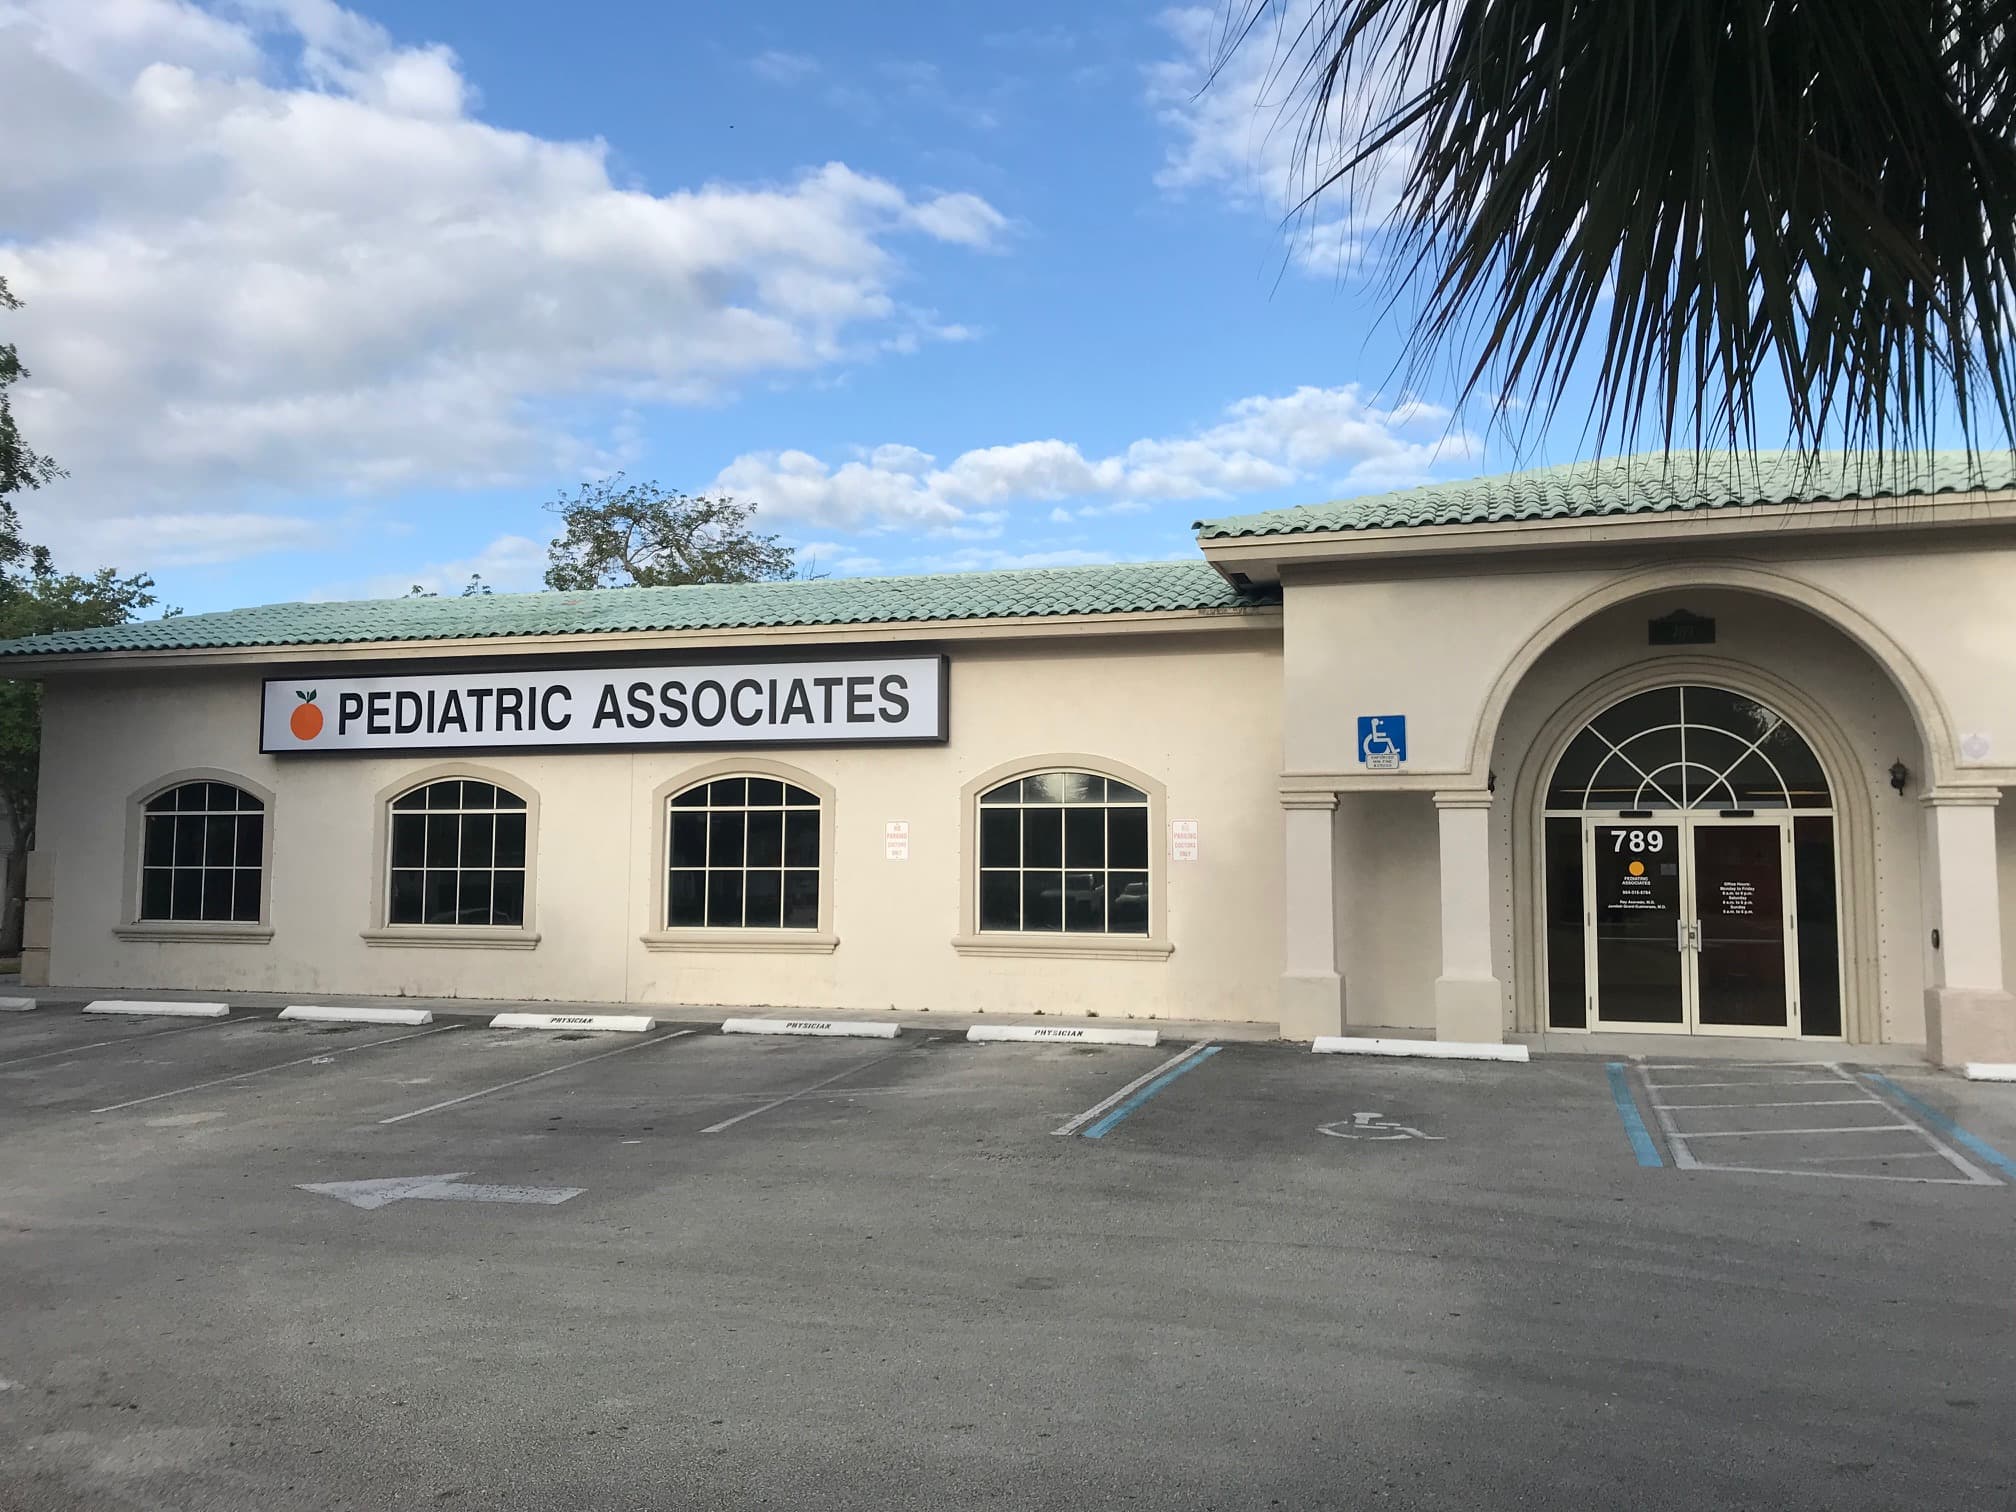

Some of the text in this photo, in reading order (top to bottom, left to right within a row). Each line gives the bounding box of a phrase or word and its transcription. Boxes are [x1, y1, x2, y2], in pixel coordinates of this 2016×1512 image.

[338, 675, 909, 736] PEDIATRIC ASSOCIATES
[1610, 830, 1664, 853] 789
[1034, 1029, 1083, 1037] PHYSICIAN
